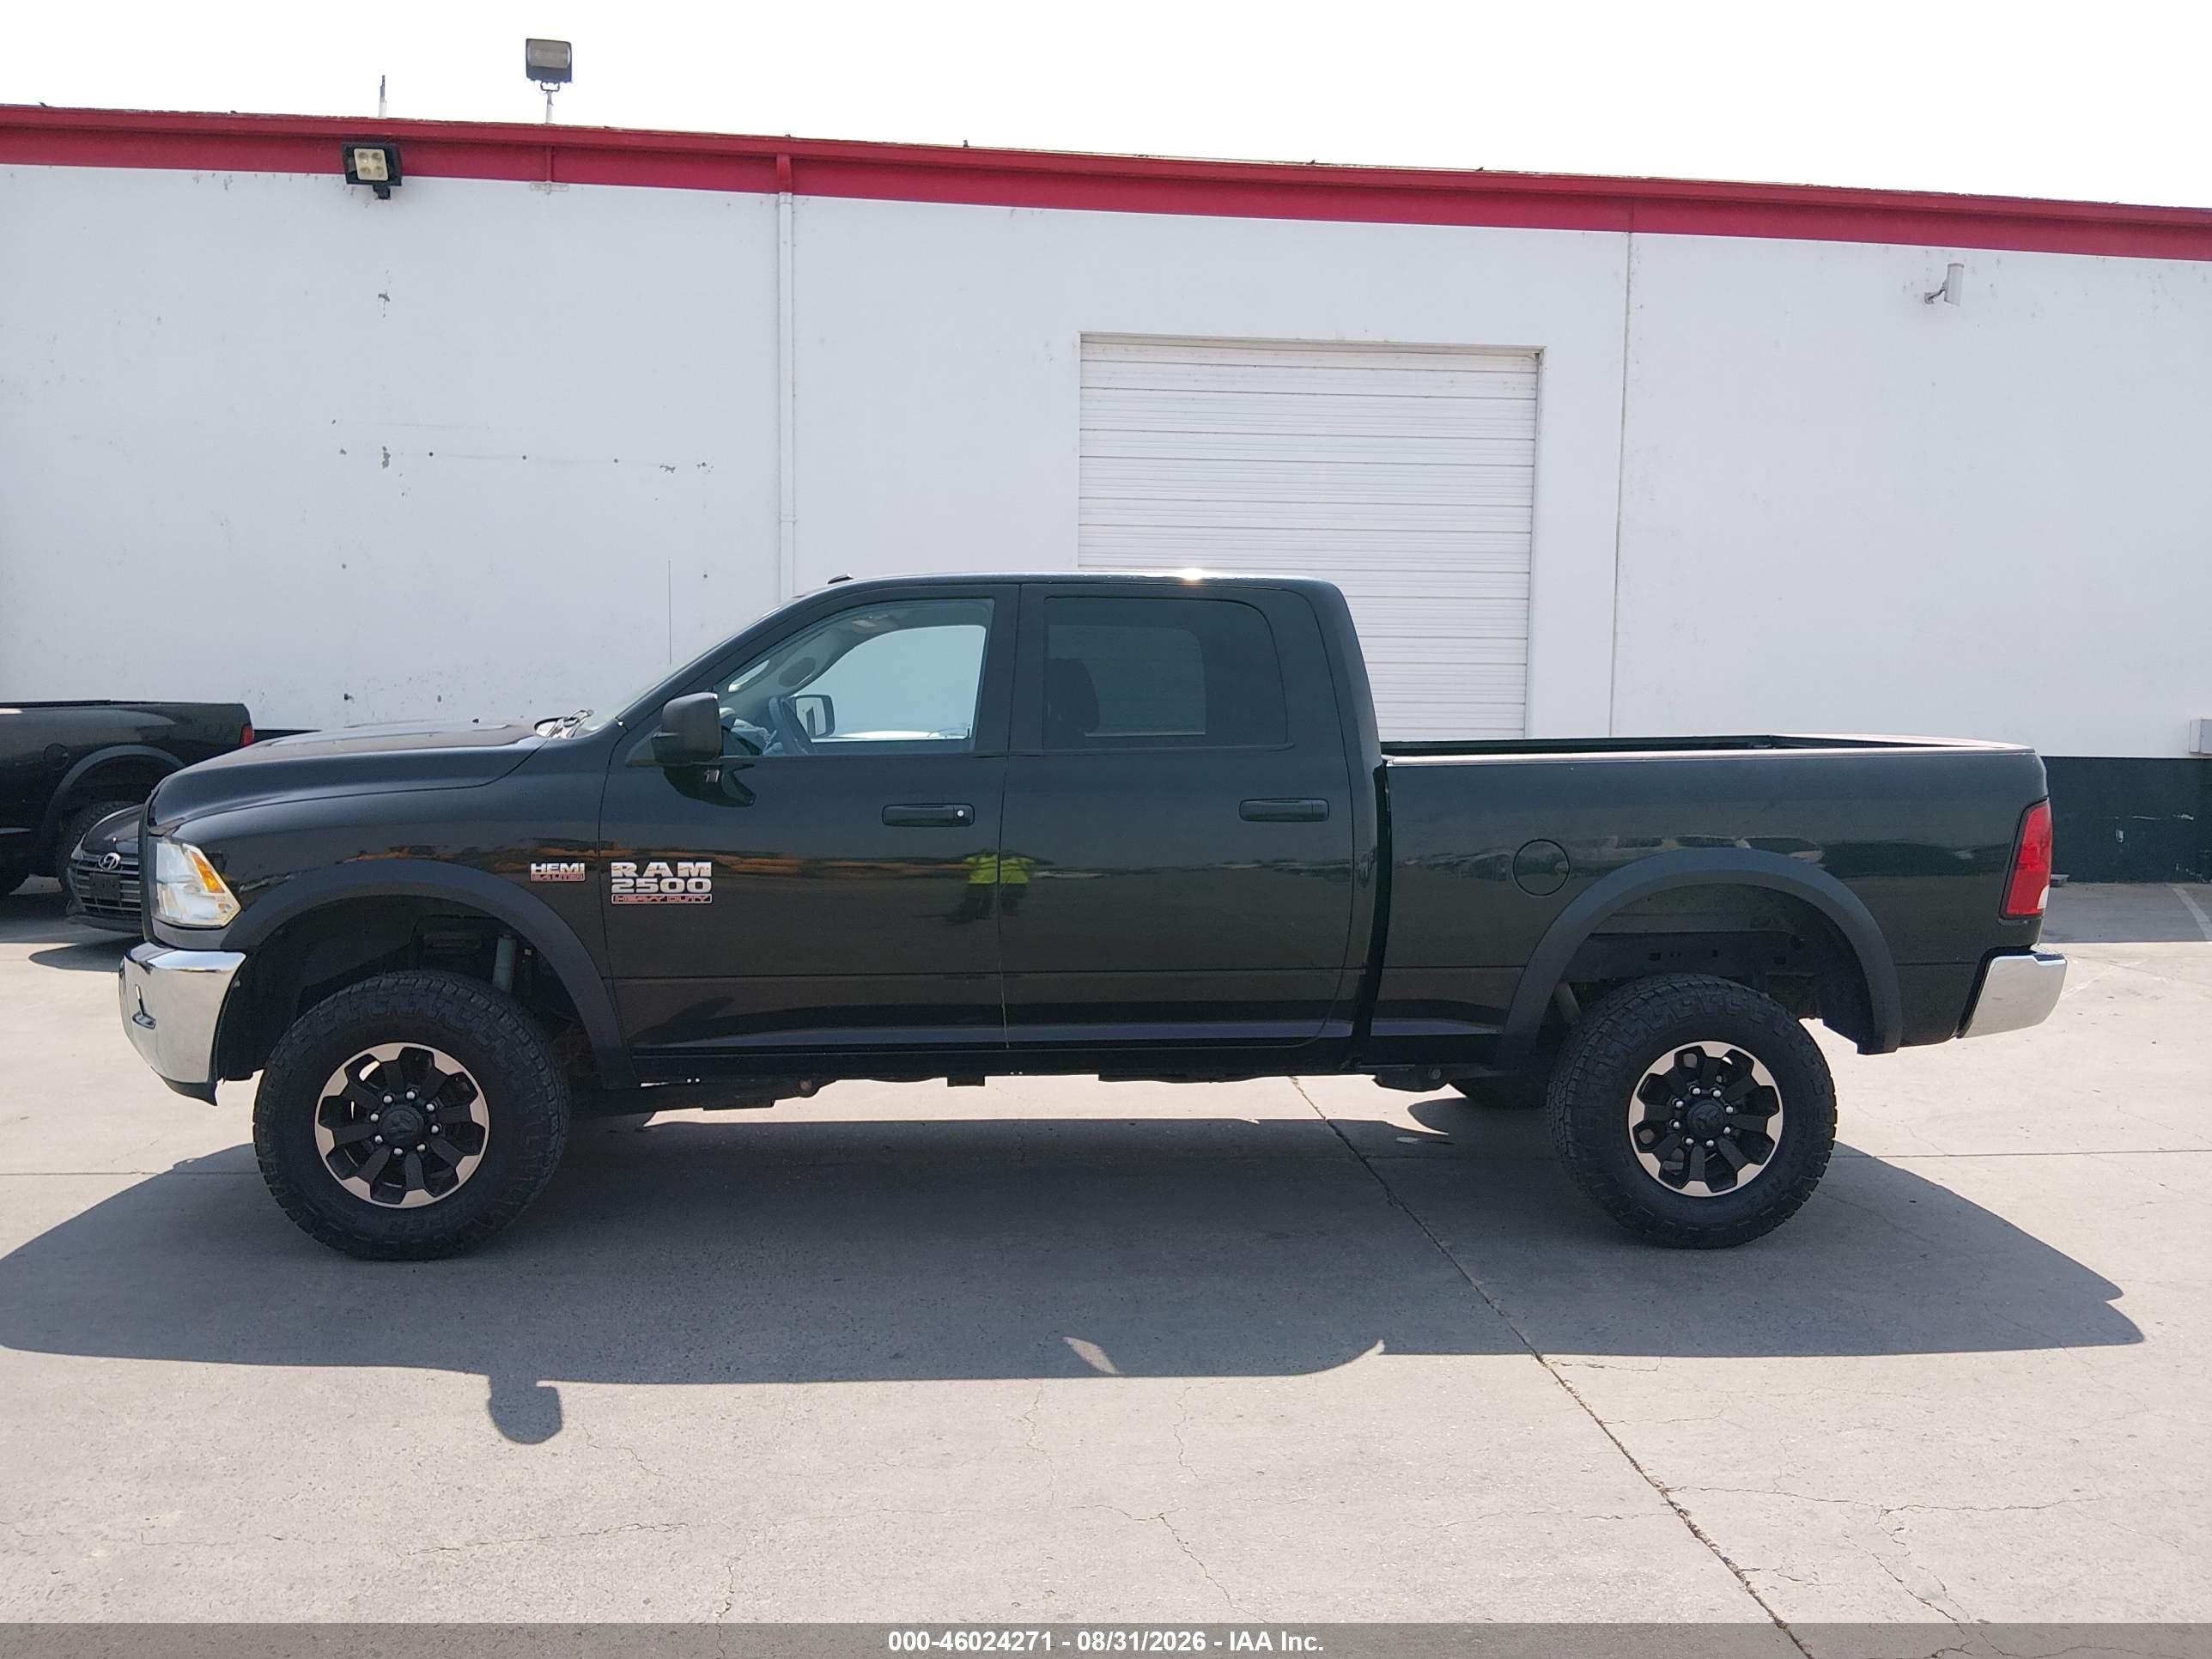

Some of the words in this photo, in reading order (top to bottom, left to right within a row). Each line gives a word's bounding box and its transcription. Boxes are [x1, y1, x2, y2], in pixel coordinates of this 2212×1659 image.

[531, 863, 585, 872] HEMI
[611, 862, 712, 877] RAM
[611, 878, 712, 893] 2500
